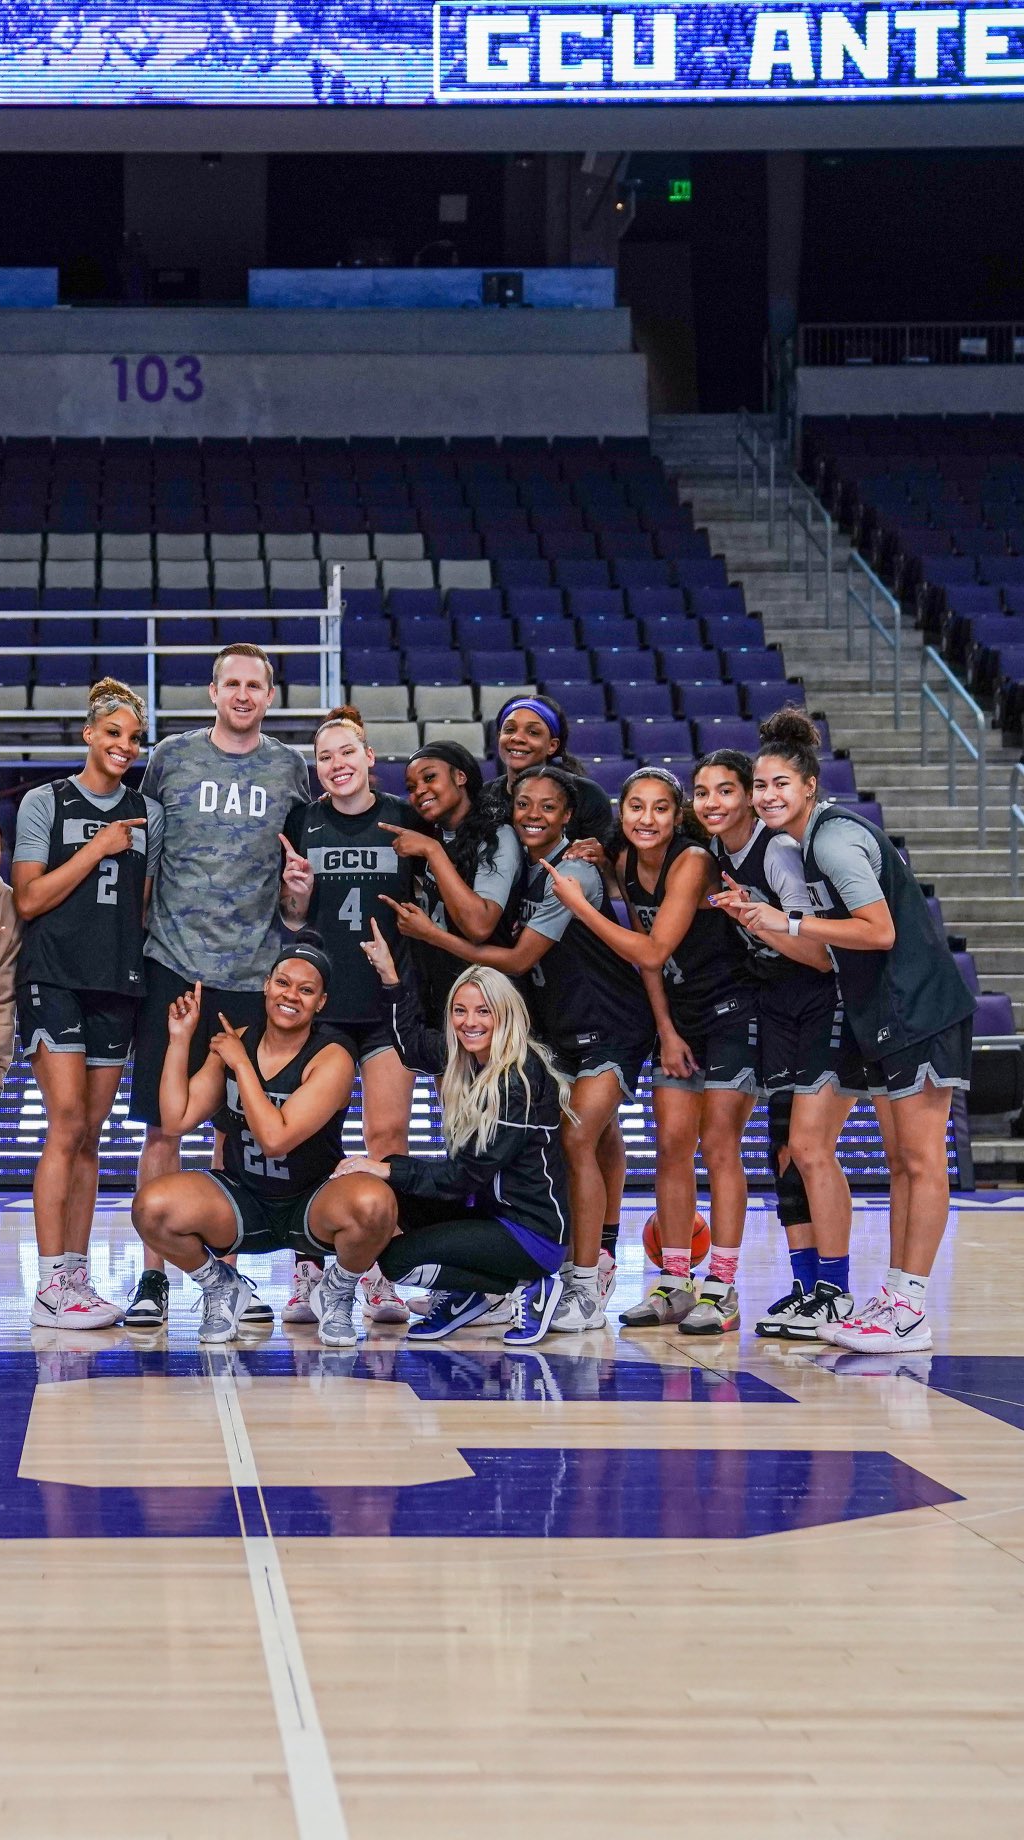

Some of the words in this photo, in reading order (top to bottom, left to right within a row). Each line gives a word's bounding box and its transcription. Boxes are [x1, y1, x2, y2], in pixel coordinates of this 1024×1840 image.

[466, 13, 676, 83] GCU
[748, 9, 1024, 81] ANTE
[110, 354, 204, 403] 103
[199, 780, 267, 818] DAD
[96, 857, 120, 906] 2
[324, 849, 378, 871] GCU
[338, 886, 363, 932] 4
